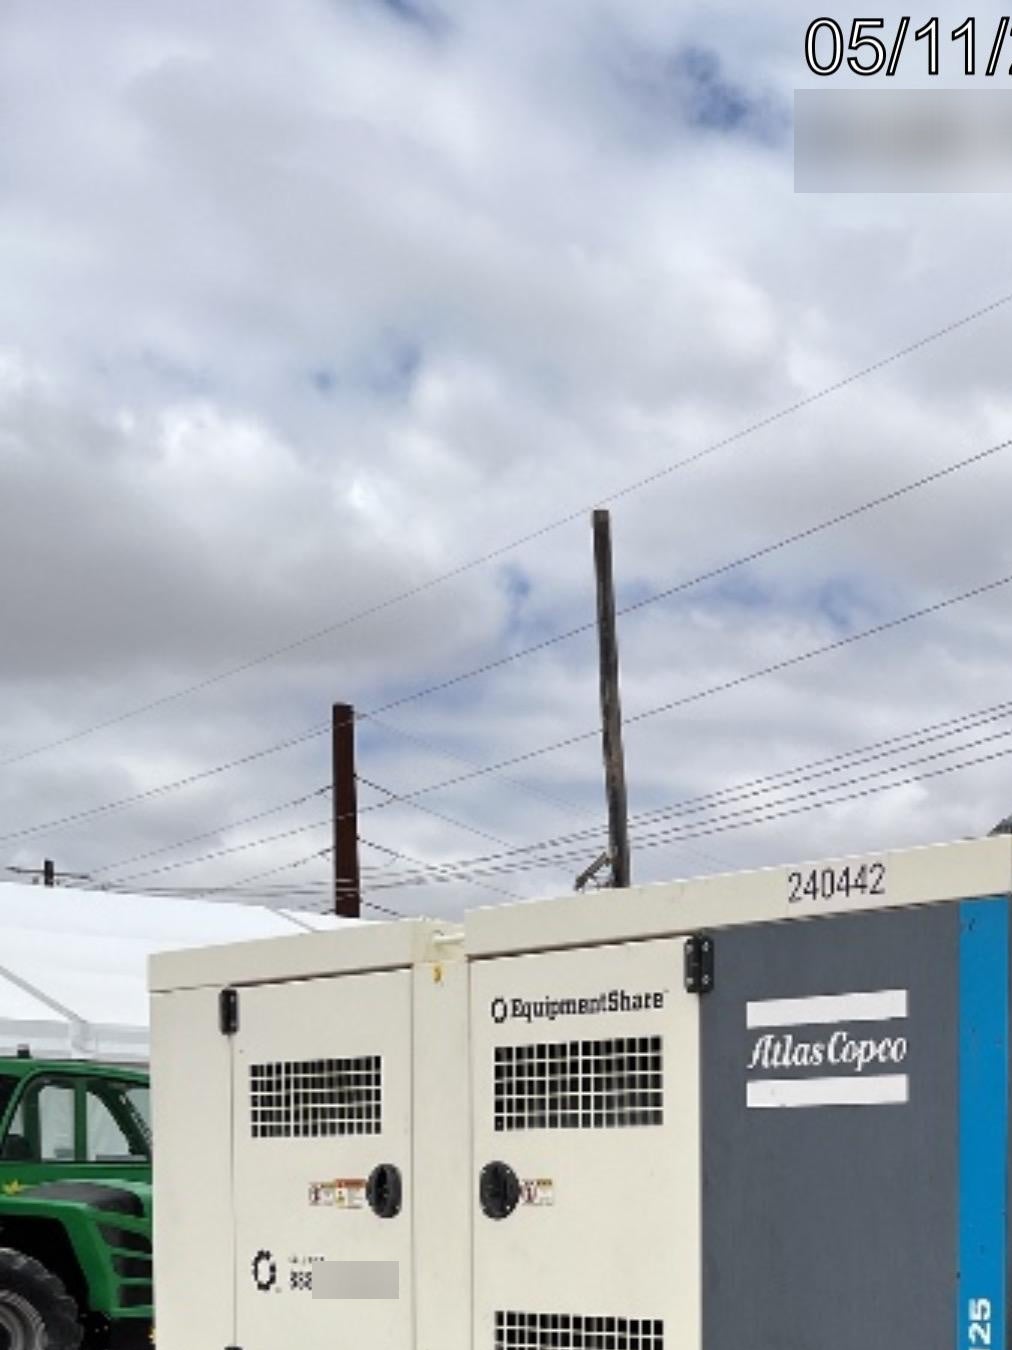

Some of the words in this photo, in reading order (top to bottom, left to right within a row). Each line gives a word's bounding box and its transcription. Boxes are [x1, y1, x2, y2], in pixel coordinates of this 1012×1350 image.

[788, 863, 885, 903] 240442
[511, 990, 664, 1023] EquipmentShare
[746, 1034, 825, 1069] Atlas
[827, 1031, 907, 1072] Copco
